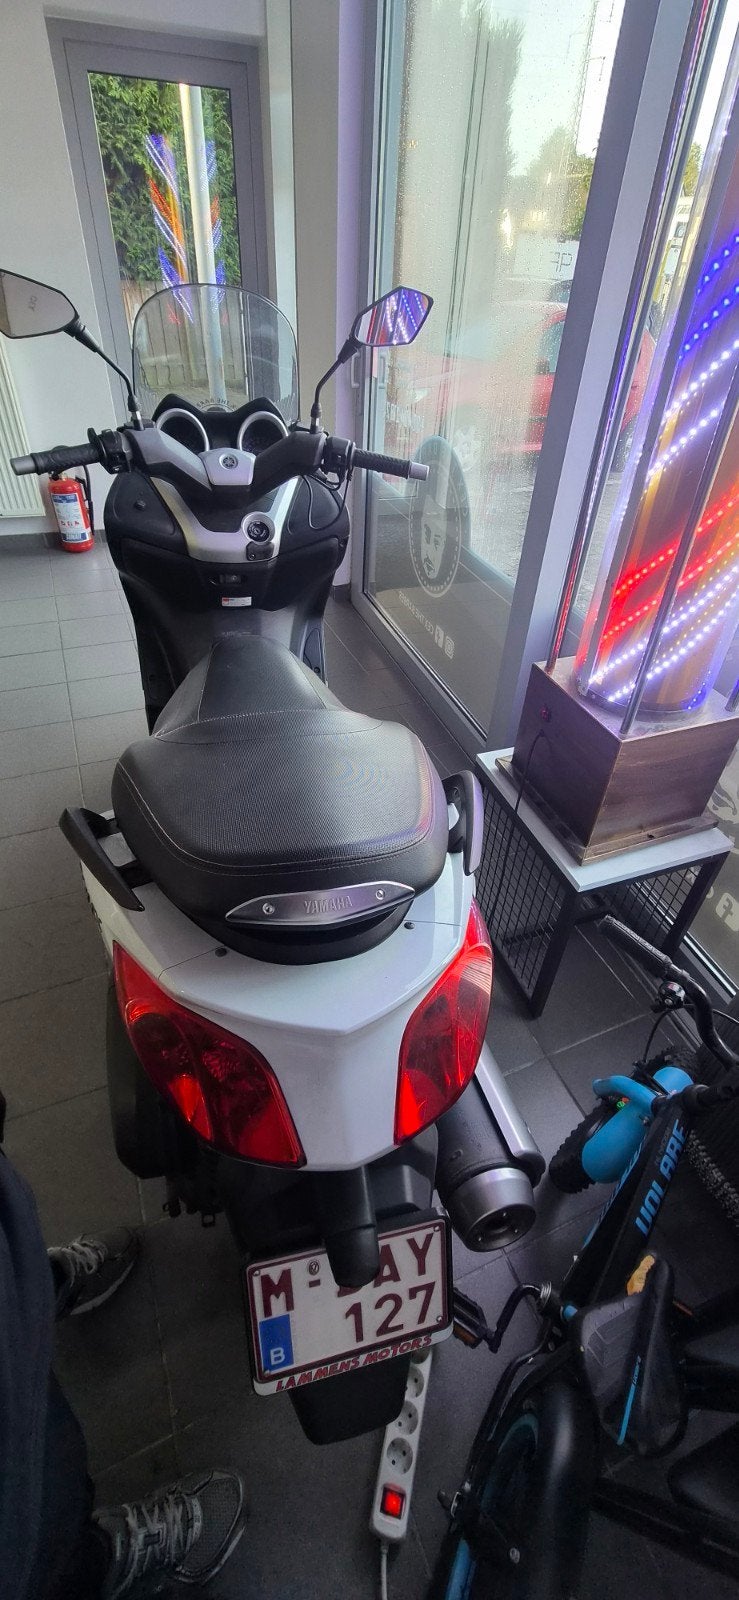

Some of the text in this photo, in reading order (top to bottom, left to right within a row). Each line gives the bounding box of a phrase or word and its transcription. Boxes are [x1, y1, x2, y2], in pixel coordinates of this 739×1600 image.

[304, 895, 353, 914] YAMAHA
[345, 1281, 436, 1344] 127
[270, 1347, 286, 1366] B
[275, 1335, 432, 1393] LAMMENS MOTORS
